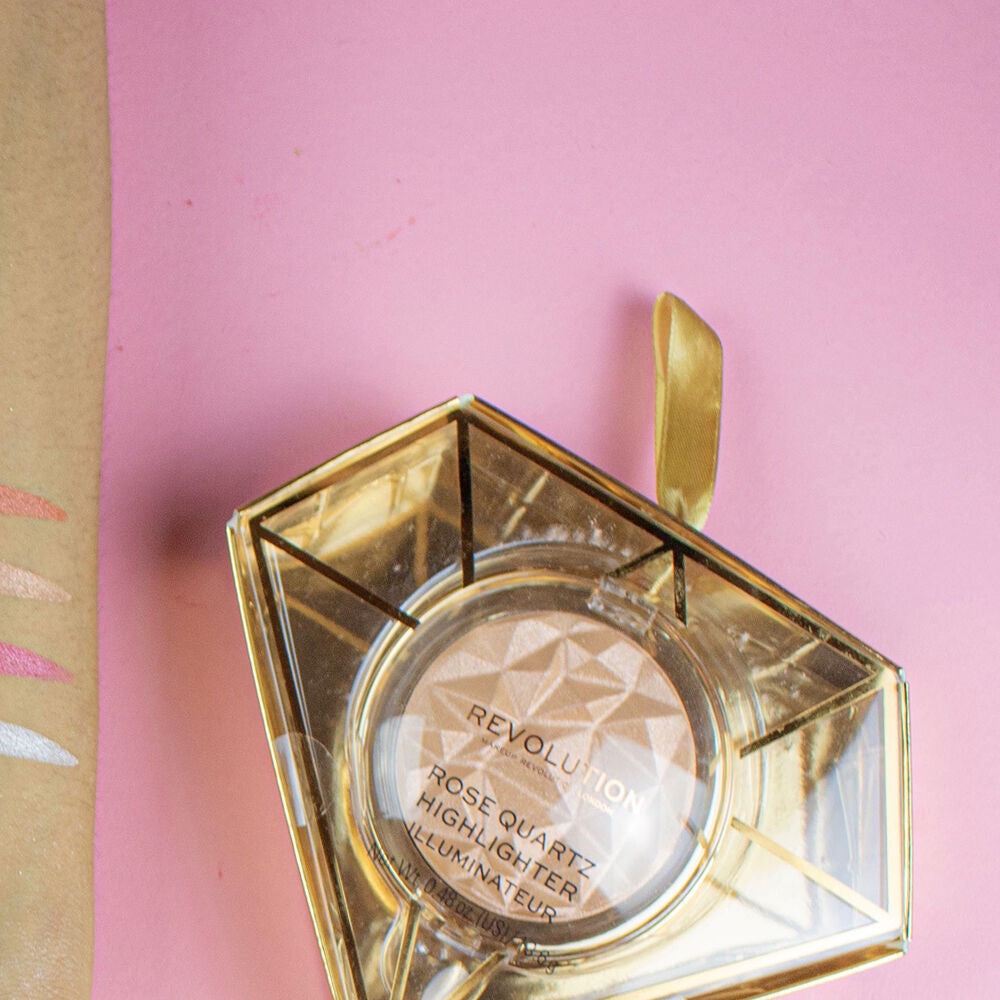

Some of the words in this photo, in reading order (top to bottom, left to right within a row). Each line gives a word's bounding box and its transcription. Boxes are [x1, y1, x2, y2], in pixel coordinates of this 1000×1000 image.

[467, 704, 646, 815] REVOLUTION
[519, 758, 574, 793] REVOLUO
[407, 822, 558, 924] ILLUMINATEUR
[416, 792, 579, 902] HIGHLIGHTER
[427, 764, 497, 817] ROSE
[499, 809, 597, 879] QUARTZ
